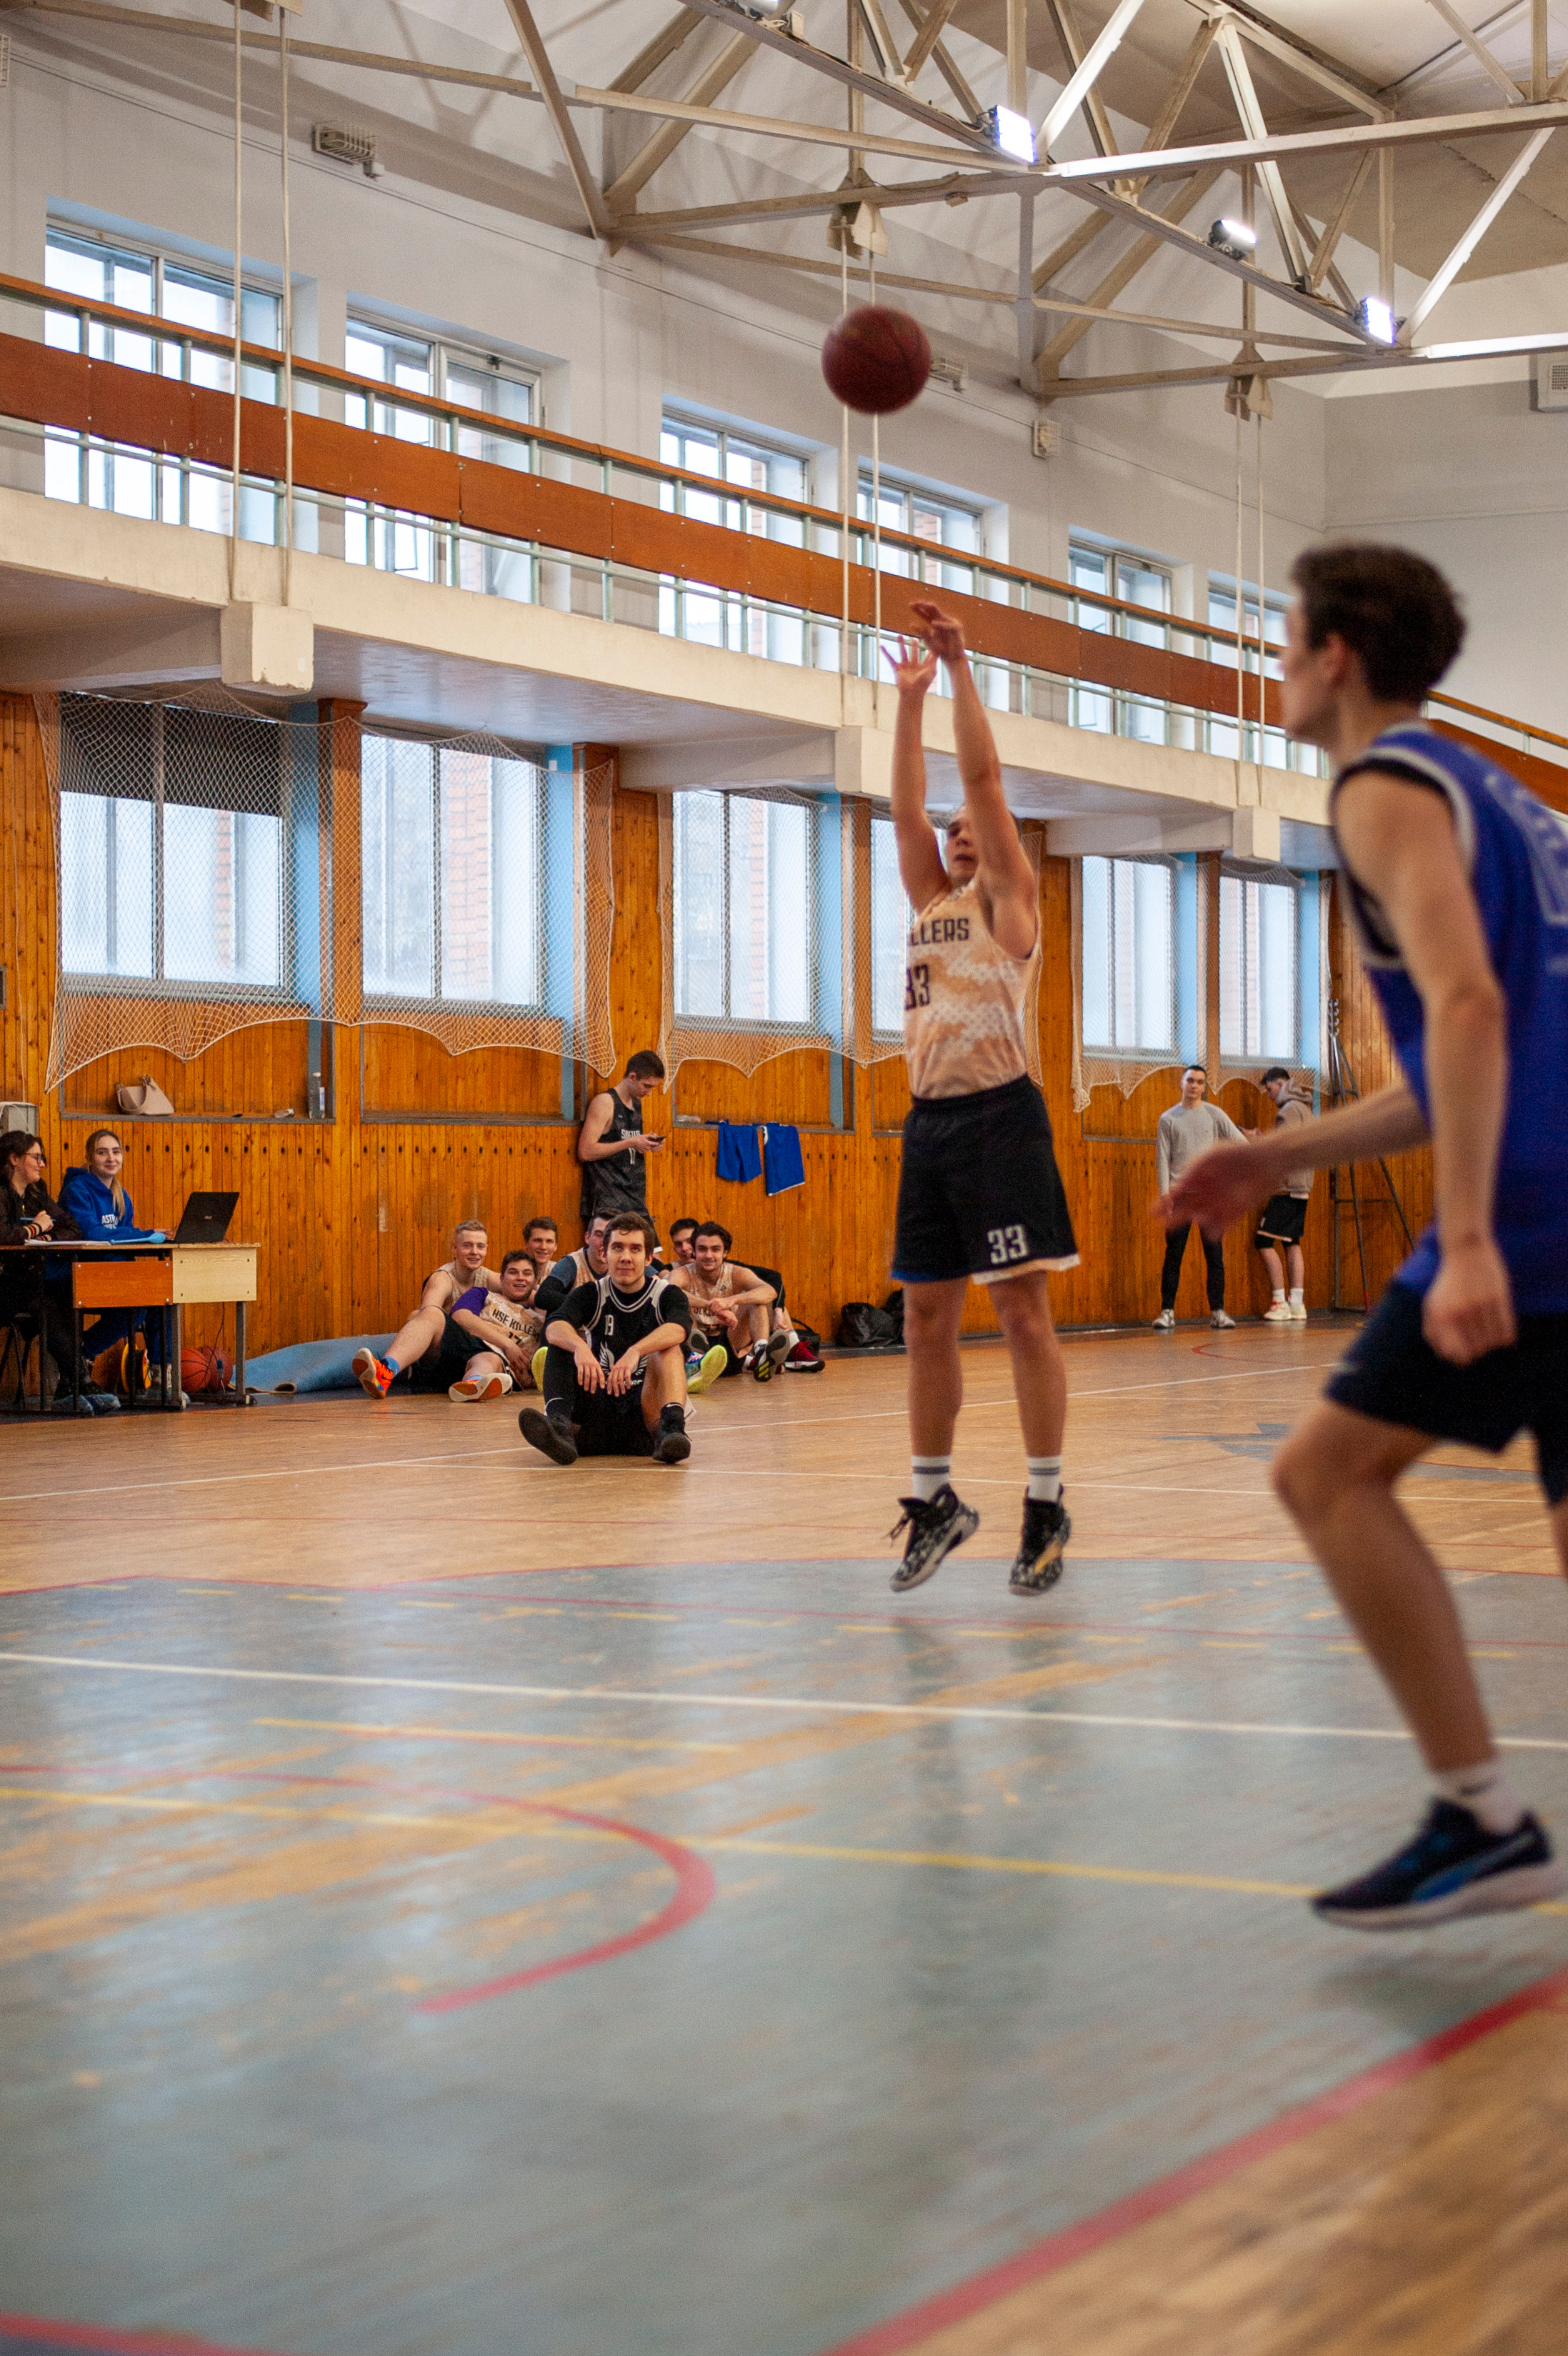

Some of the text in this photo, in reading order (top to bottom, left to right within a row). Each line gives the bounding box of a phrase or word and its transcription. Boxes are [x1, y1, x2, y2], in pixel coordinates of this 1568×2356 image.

[908, 917, 969, 946] LLERS
[987, 1224, 1027, 1264] 33
[492, 1309, 539, 1339] HSE KILLER
